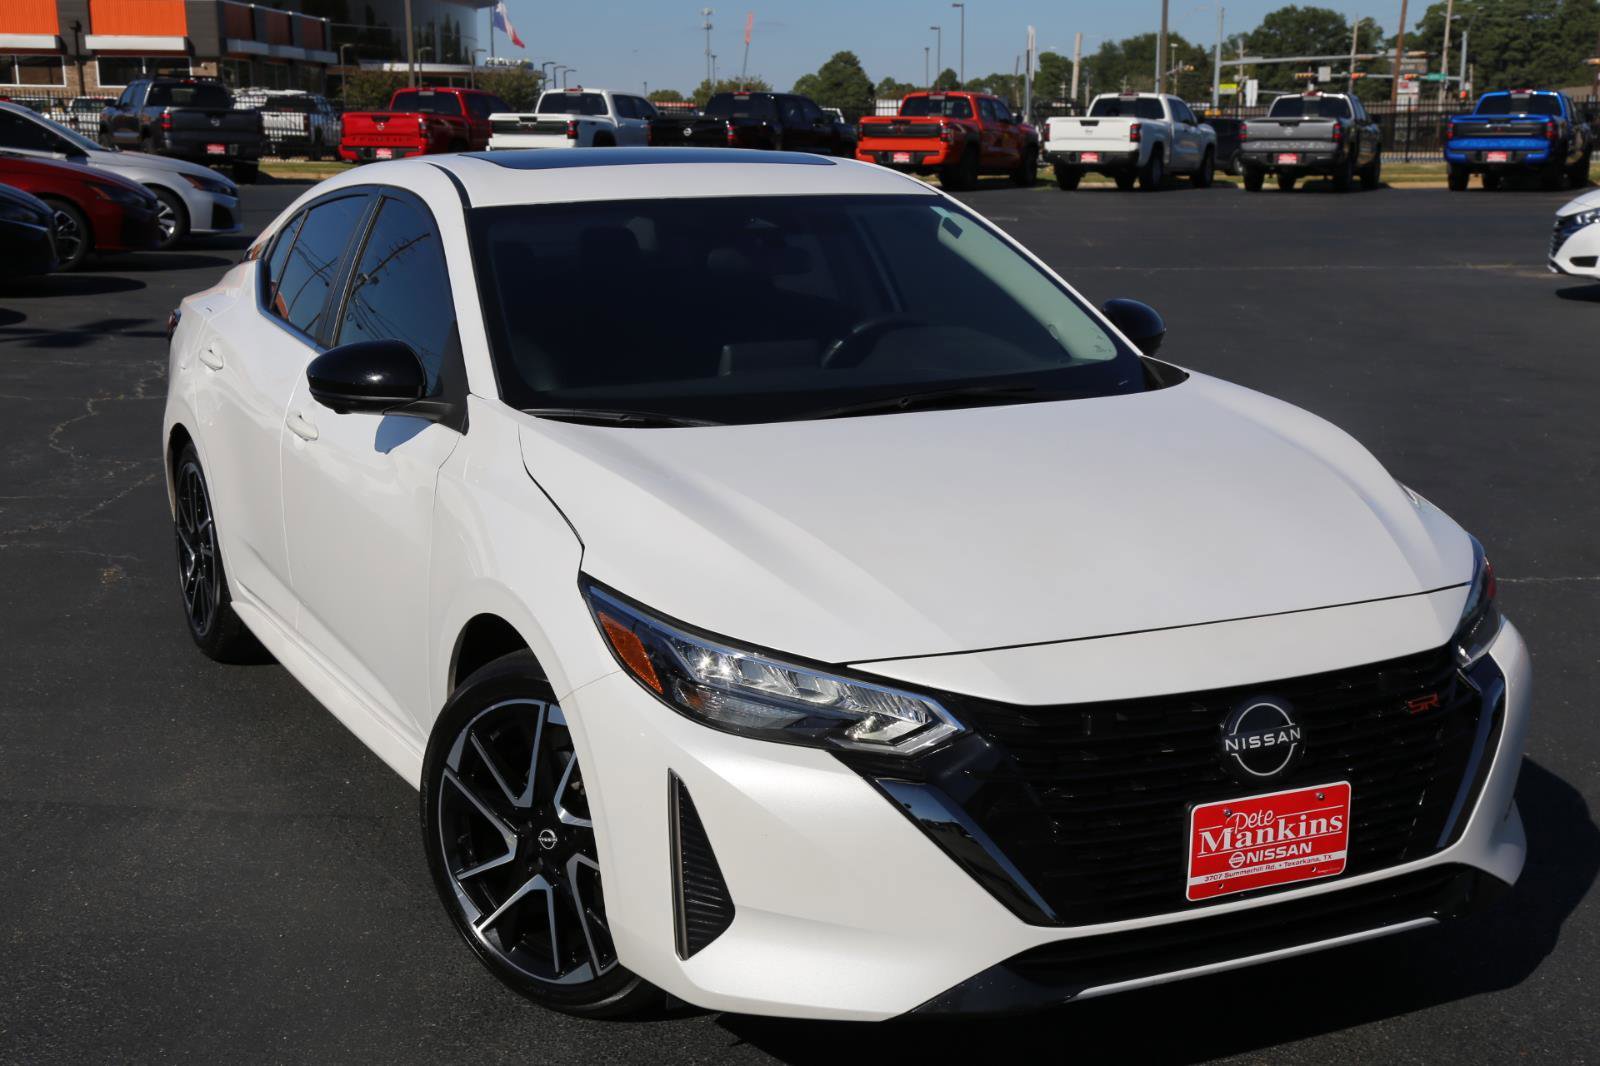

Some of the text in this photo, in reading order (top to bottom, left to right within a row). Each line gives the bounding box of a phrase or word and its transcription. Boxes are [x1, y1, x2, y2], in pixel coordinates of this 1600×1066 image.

[1224, 727, 1301, 752] NISSAN
[1225, 809, 1276, 834] Pete
[1199, 814, 1344, 855] Mankins
[1246, 842, 1313, 864] NISSAN
[1204, 872, 1223, 882] 3707
[1323, 853, 1333, 861] TX
